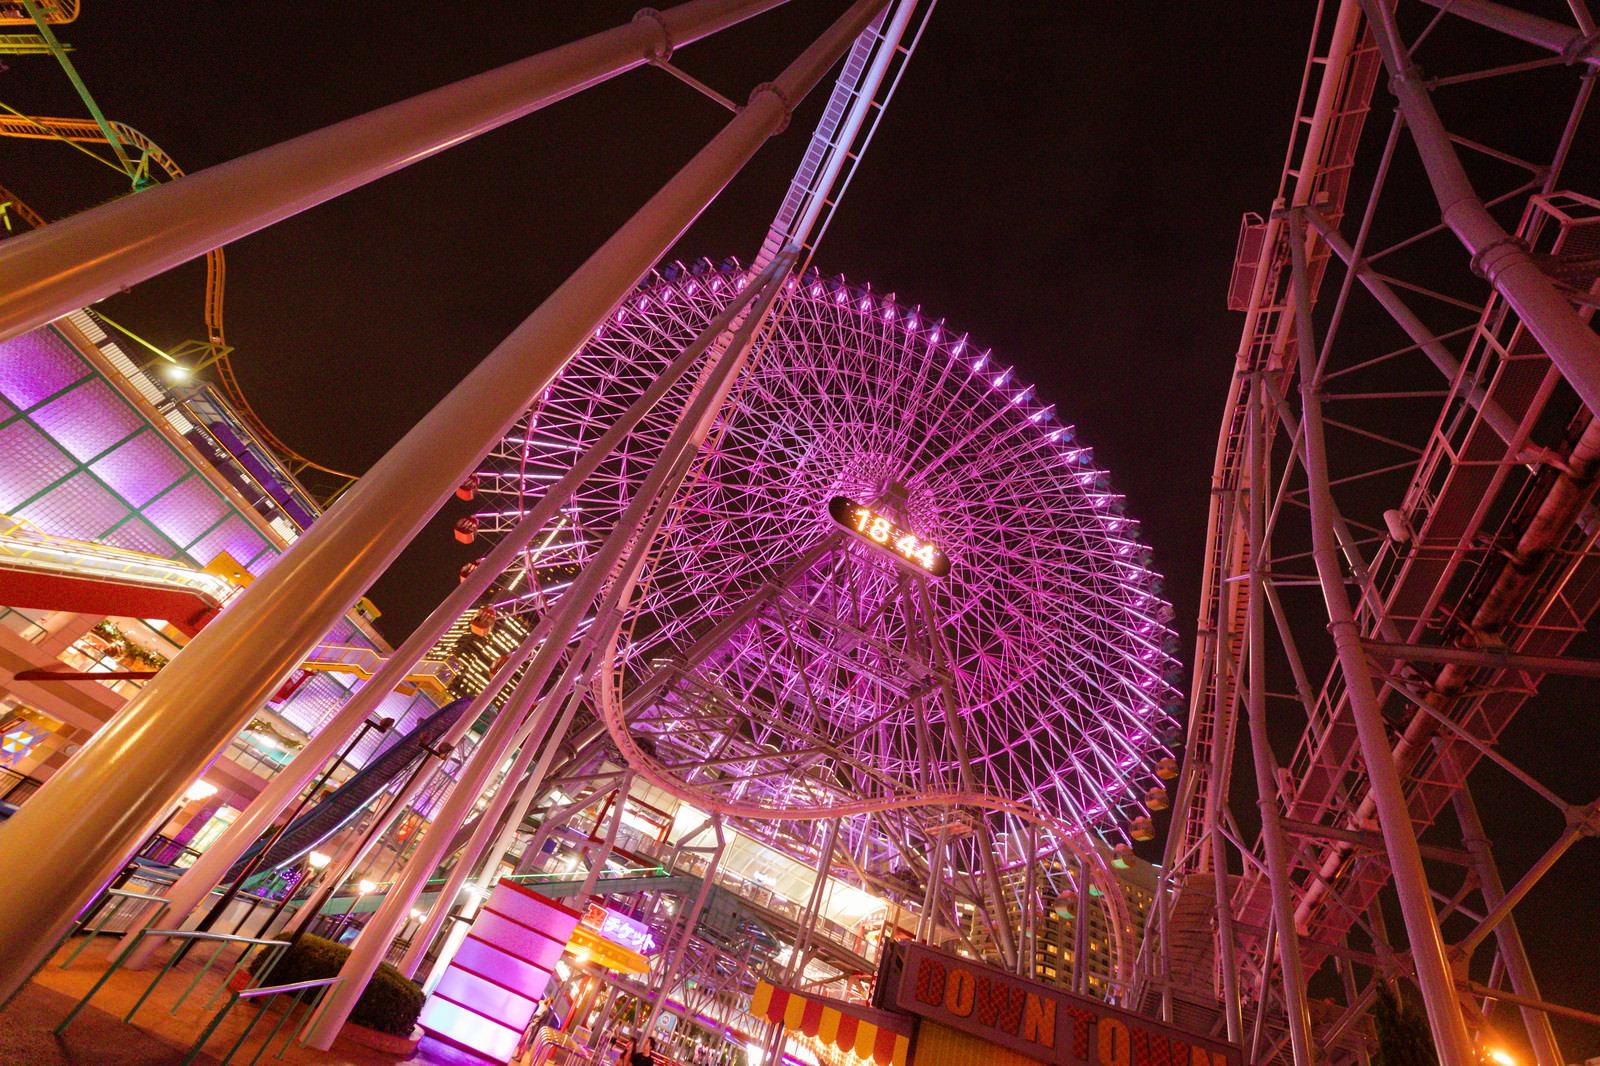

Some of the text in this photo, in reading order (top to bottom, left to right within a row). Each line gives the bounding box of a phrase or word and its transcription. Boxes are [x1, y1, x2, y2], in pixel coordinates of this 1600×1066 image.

[604, 917, 656, 951] チケット
[914, 957, 1057, 1049] DOWN
